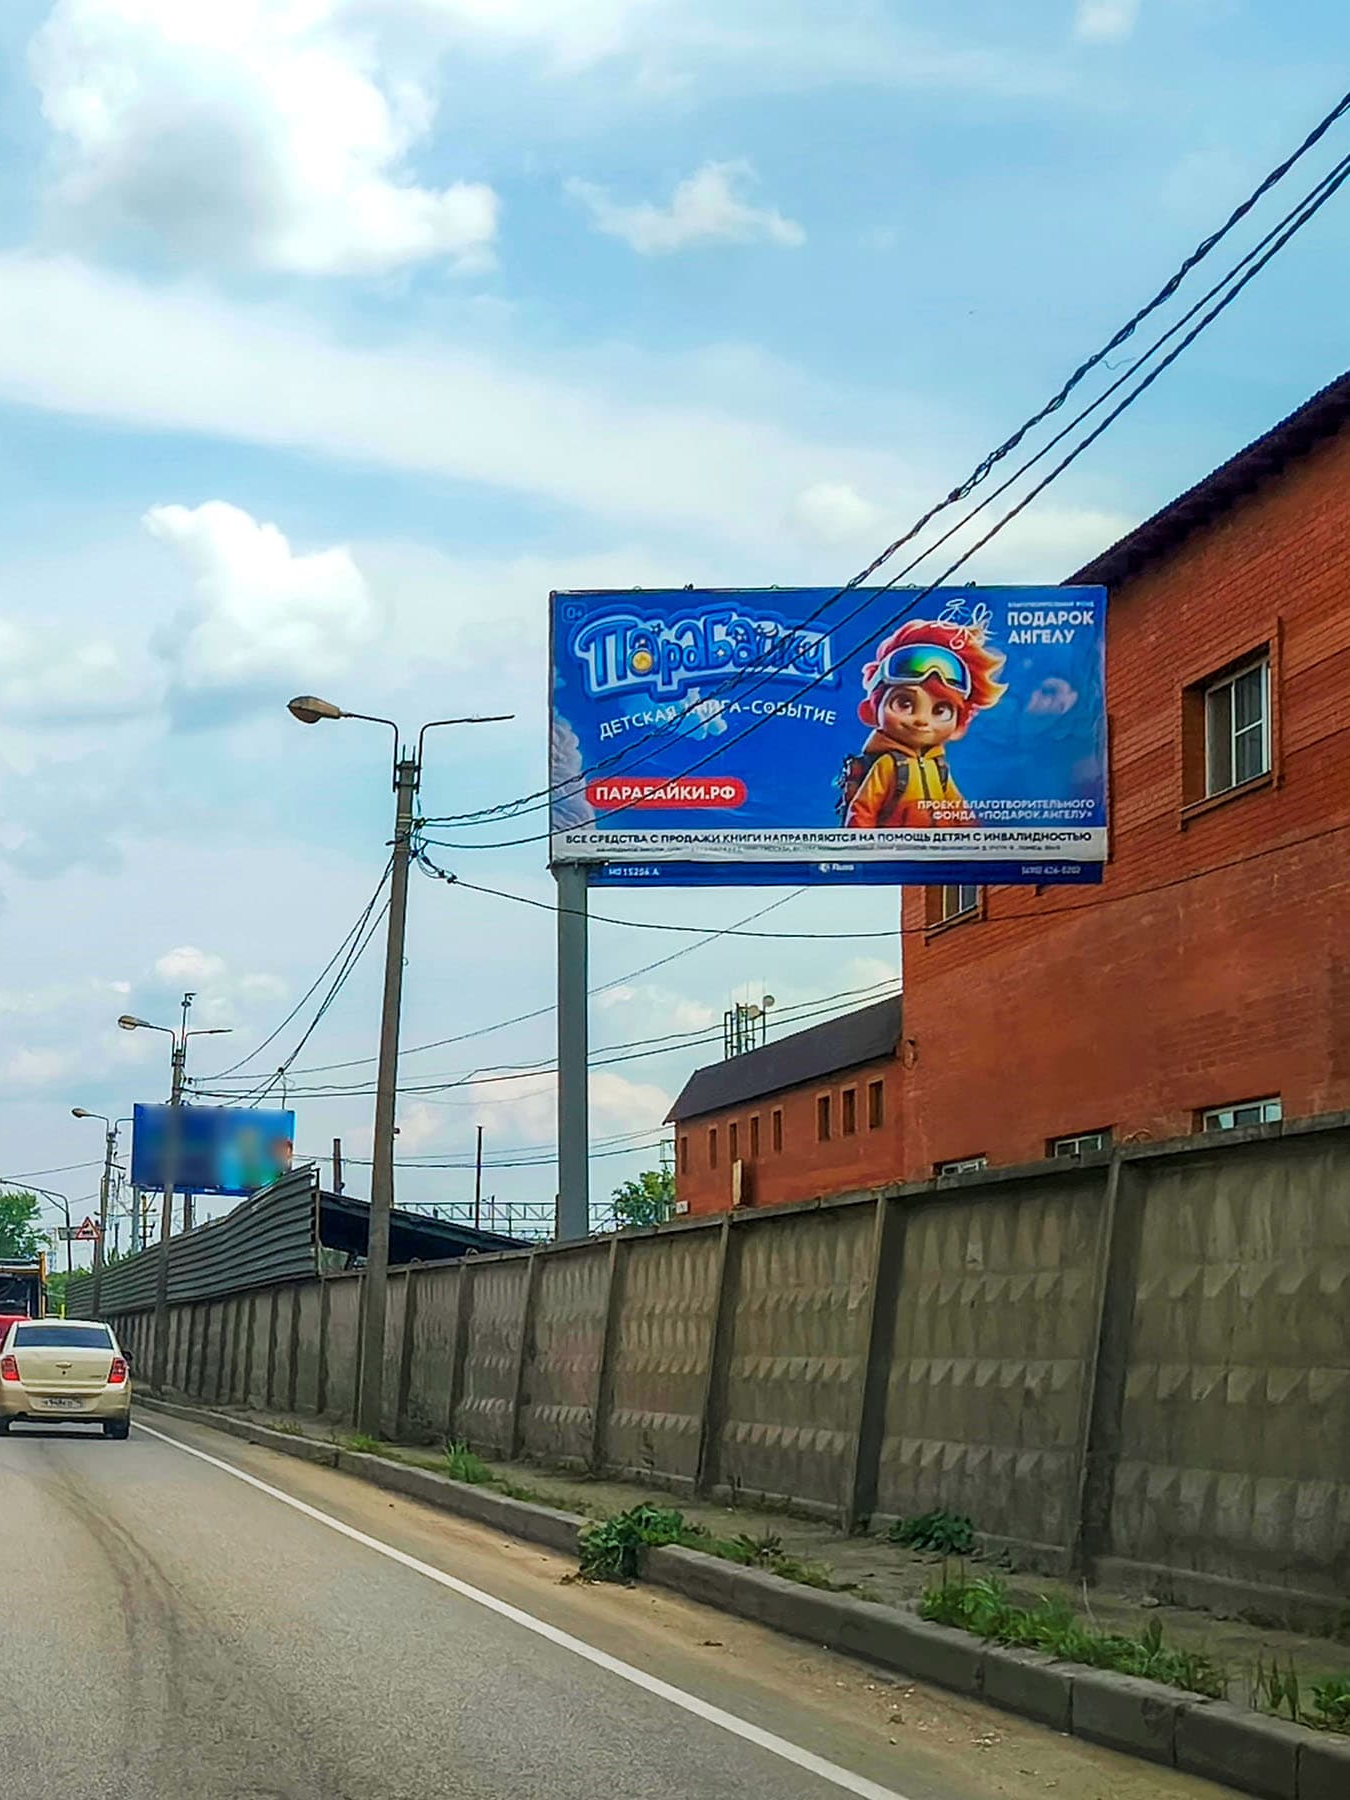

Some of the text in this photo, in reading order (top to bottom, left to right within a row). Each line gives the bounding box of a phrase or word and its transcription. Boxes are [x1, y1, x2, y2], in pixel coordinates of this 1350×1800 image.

[1007, 611, 1094, 627] ПОДАРОК
[1008, 629, 1075, 644] АНГЕЛУ
[599, 706, 677, 741] ДЕТСКАЯ
[596, 783, 736, 801] ПАРАБАЙКИ.РФ
[918, 799, 961, 810] ПРОЕКТ
[933, 810, 976, 820] ФОНДА
[566, 832, 1092, 844] ВСЕ СРЕДСТВА С ПРОДАЖИ КНИГИ НАПРАВЛЯЮТСЯ НА ПОМОЩЬ ДЕТЯМ С ИНВАЛИДНОСТЬЮ
